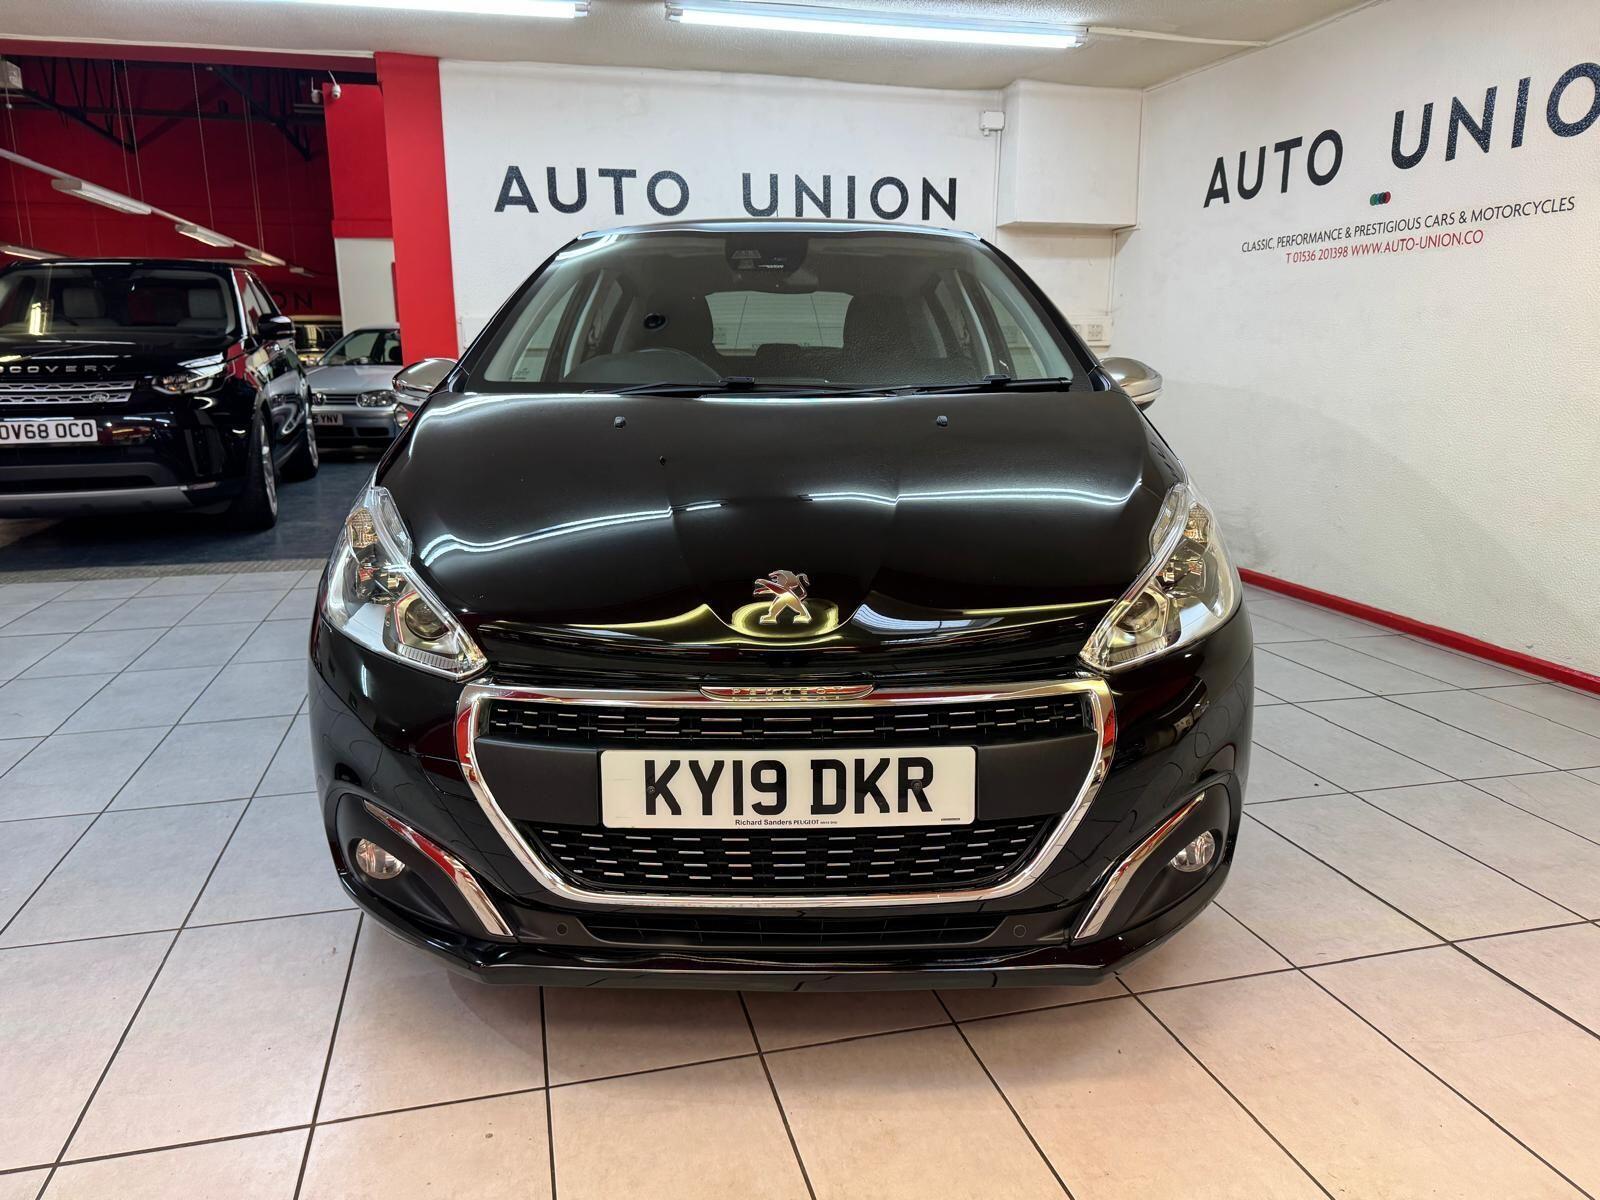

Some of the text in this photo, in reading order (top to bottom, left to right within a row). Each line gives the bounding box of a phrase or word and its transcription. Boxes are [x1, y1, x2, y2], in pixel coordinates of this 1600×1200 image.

[1203, 62, 1600, 208] AUTO UNIO
[494, 165, 958, 221] AUTO UNION
[1241, 196, 1576, 253] CLASSIC, PERFORMANCE & PRESTIGIOUS CARS & MOTORCYCLES
[1286, 229, 1484, 264] T 01536 201398 WWW.AUTO-UNION.CO
[644, 756, 934, 816] KY19 DKR
